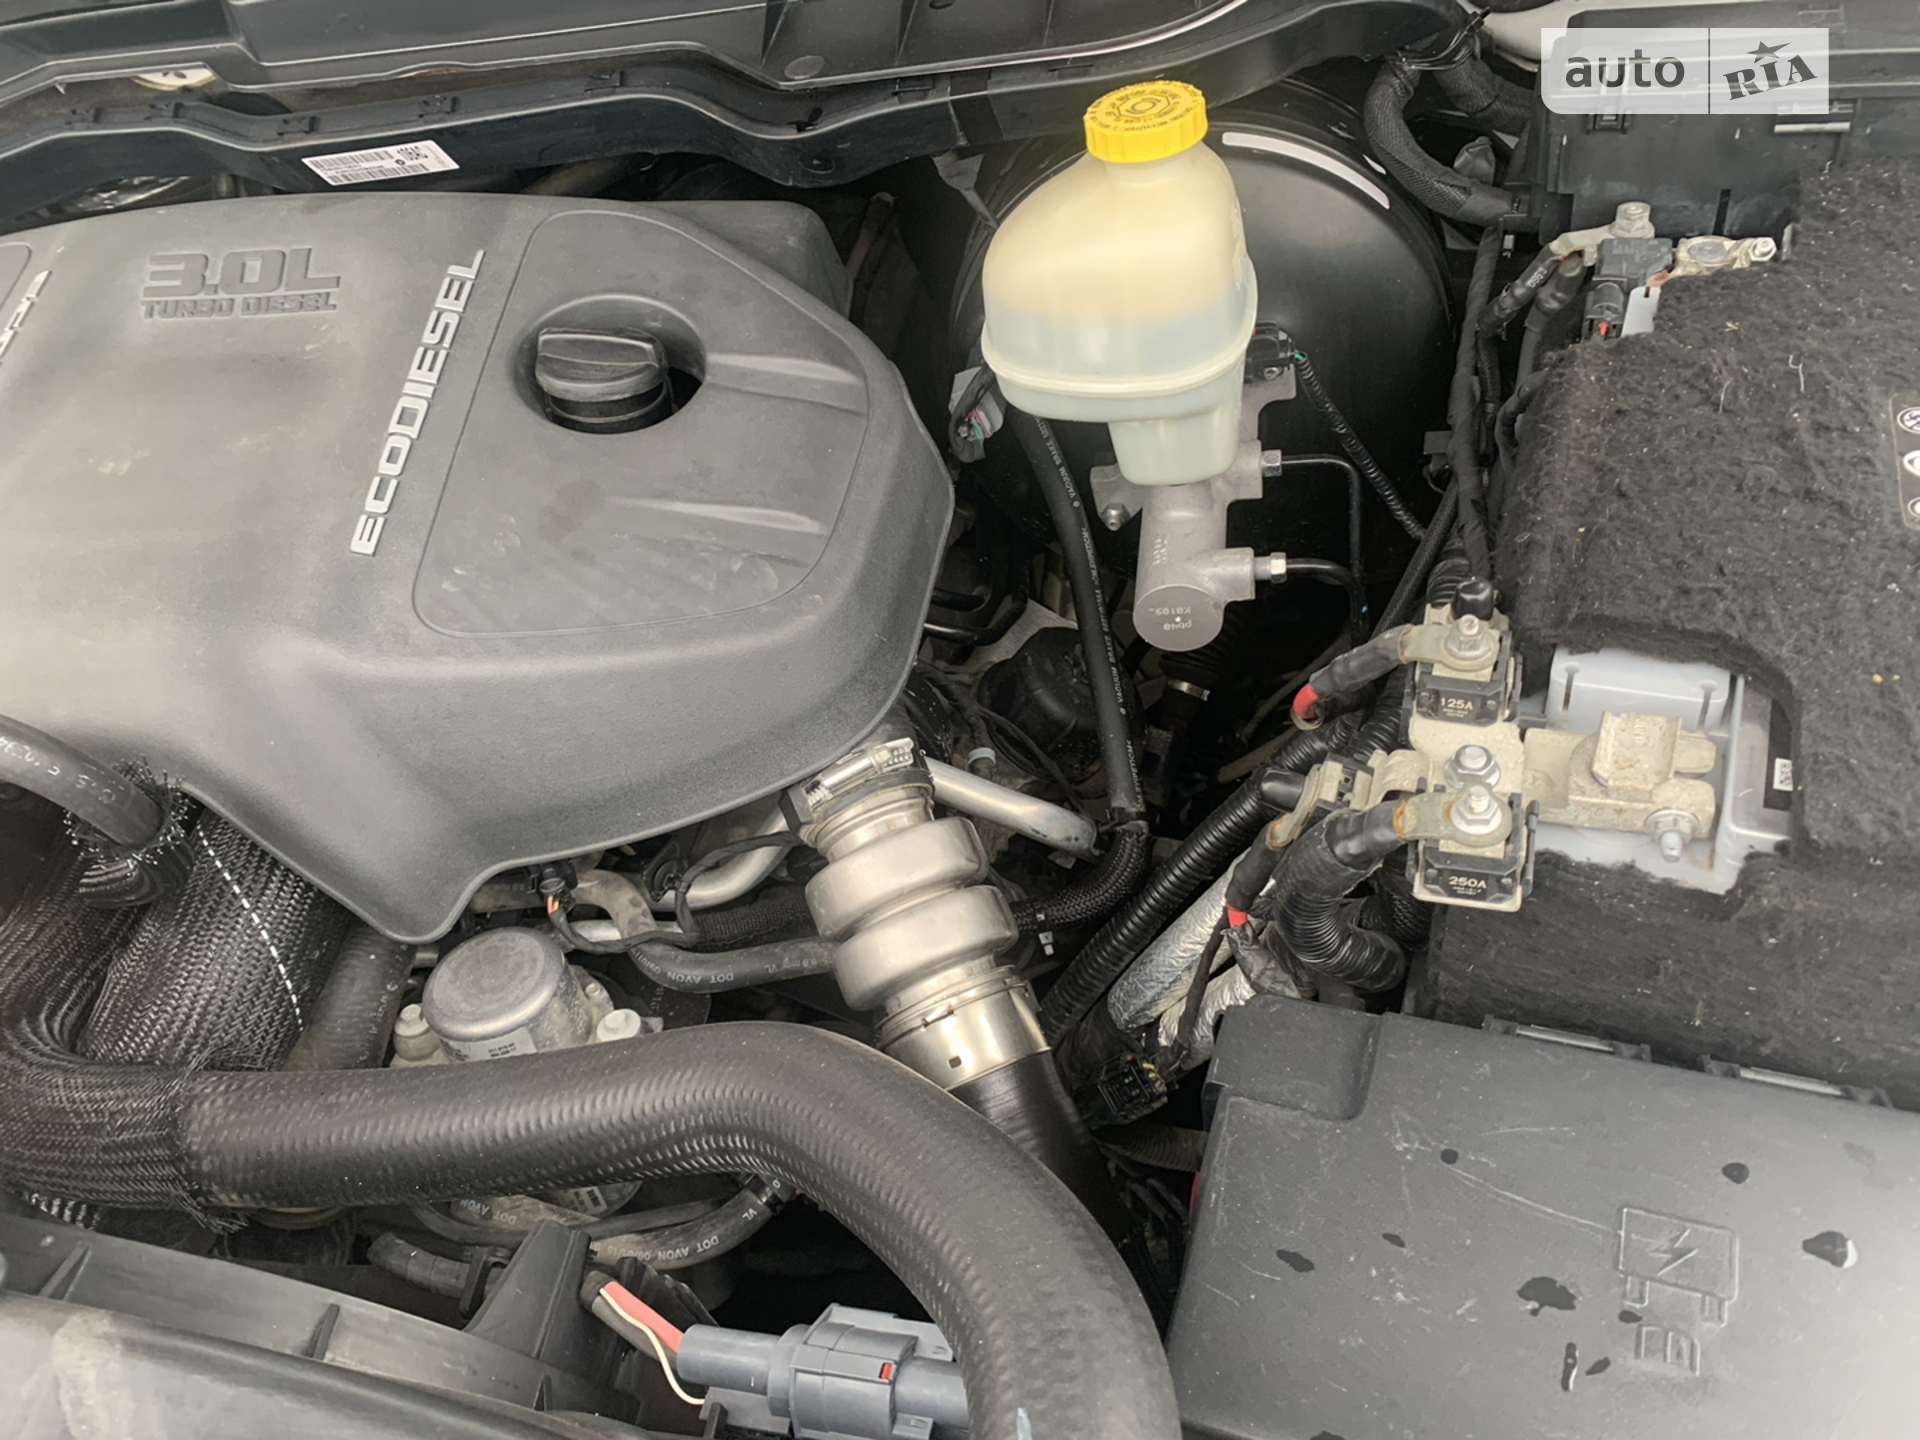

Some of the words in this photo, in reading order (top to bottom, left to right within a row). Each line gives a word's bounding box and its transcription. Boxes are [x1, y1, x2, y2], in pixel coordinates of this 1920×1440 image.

[143, 247, 341, 298] 3.0L
[141, 298, 235, 319] TURBO
[240, 292, 337, 316] DIESEL
[350, 249, 485, 557] ECODIESEL
[1058, 466, 1076, 499] VACUUM
[1440, 697, 1473, 711] 125A
[1448, 876, 1487, 889] 250A
[667, 971, 702, 984] AVON
[709, 972, 734, 984] DOT
[458, 1198, 490, 1216] AVON
[492, 1210, 518, 1225] DOT
[741, 1208, 758, 1222] VL
[695, 1235, 720, 1253] DOT
[657, 1246, 690, 1260] AVON
